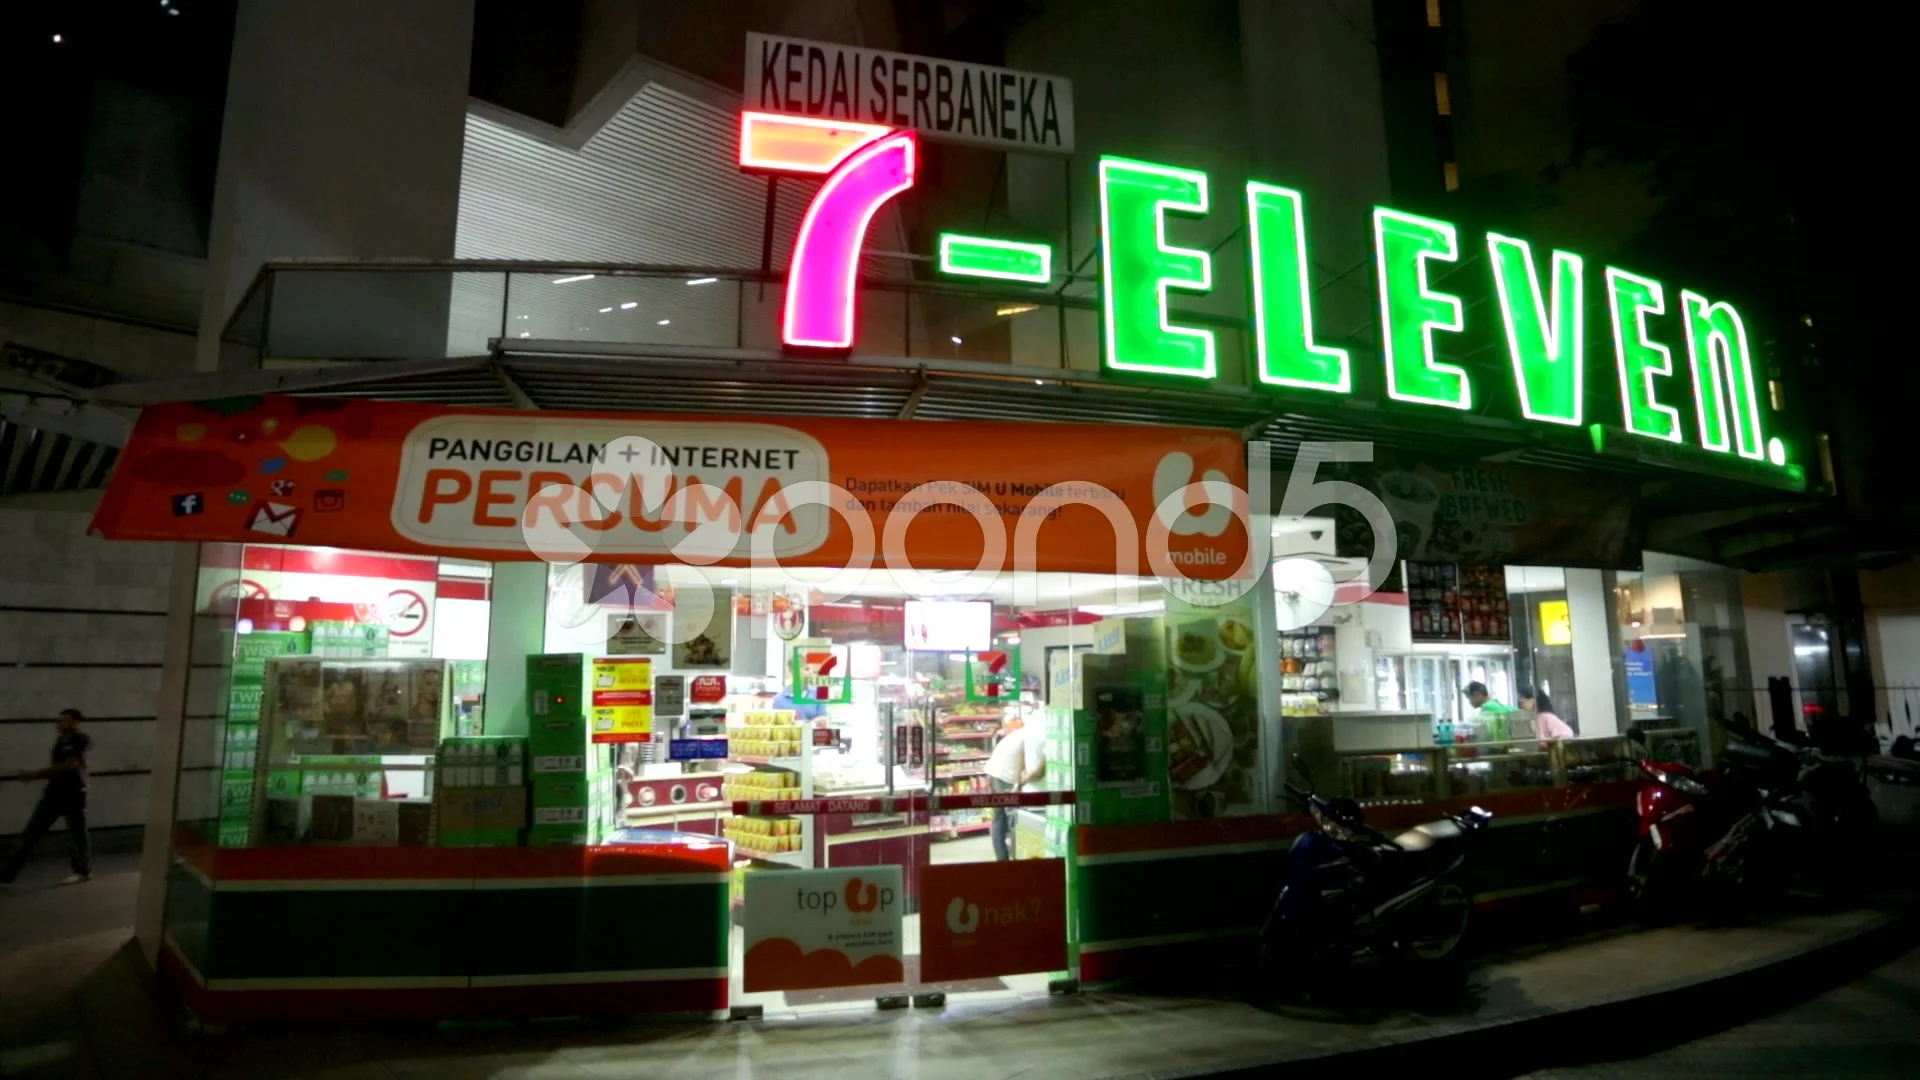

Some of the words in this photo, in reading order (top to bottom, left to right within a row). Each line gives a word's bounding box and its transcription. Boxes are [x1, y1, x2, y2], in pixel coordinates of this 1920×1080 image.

[760, 40, 860, 119] KEDAI
[869, 55, 1061, 147] SERBANEKA
[428, 438, 607, 466] PANGGILAN
[650, 444, 800, 471] INTERNET
[845, 477, 922, 496] Dapatkan
[928, 480, 957, 496] Pek
[961, 481, 990, 496] SIM
[995, 482, 1007, 496] U
[1011, 482, 1063, 497] Mobile
[1066, 484, 1126, 501] terbaru
[1450, 465, 1512, 493] FRESH
[417, 468, 798, 536] PERCUMA
[845, 496, 876, 512] dan
[879, 497, 943, 514] tambah
[946, 498, 981, 515] nilai
[984, 502, 1063, 521] sekarang!
[1444, 494, 1527, 523] BREWED
[1166, 547, 1228, 566] mobile
[1168, 578, 1242, 597] FRESH
[774, 801, 821, 814] SELAMAT
[827, 800, 870, 812] DATANG
[970, 794, 1020, 807] WELCOME
[797, 888, 837, 914] top
